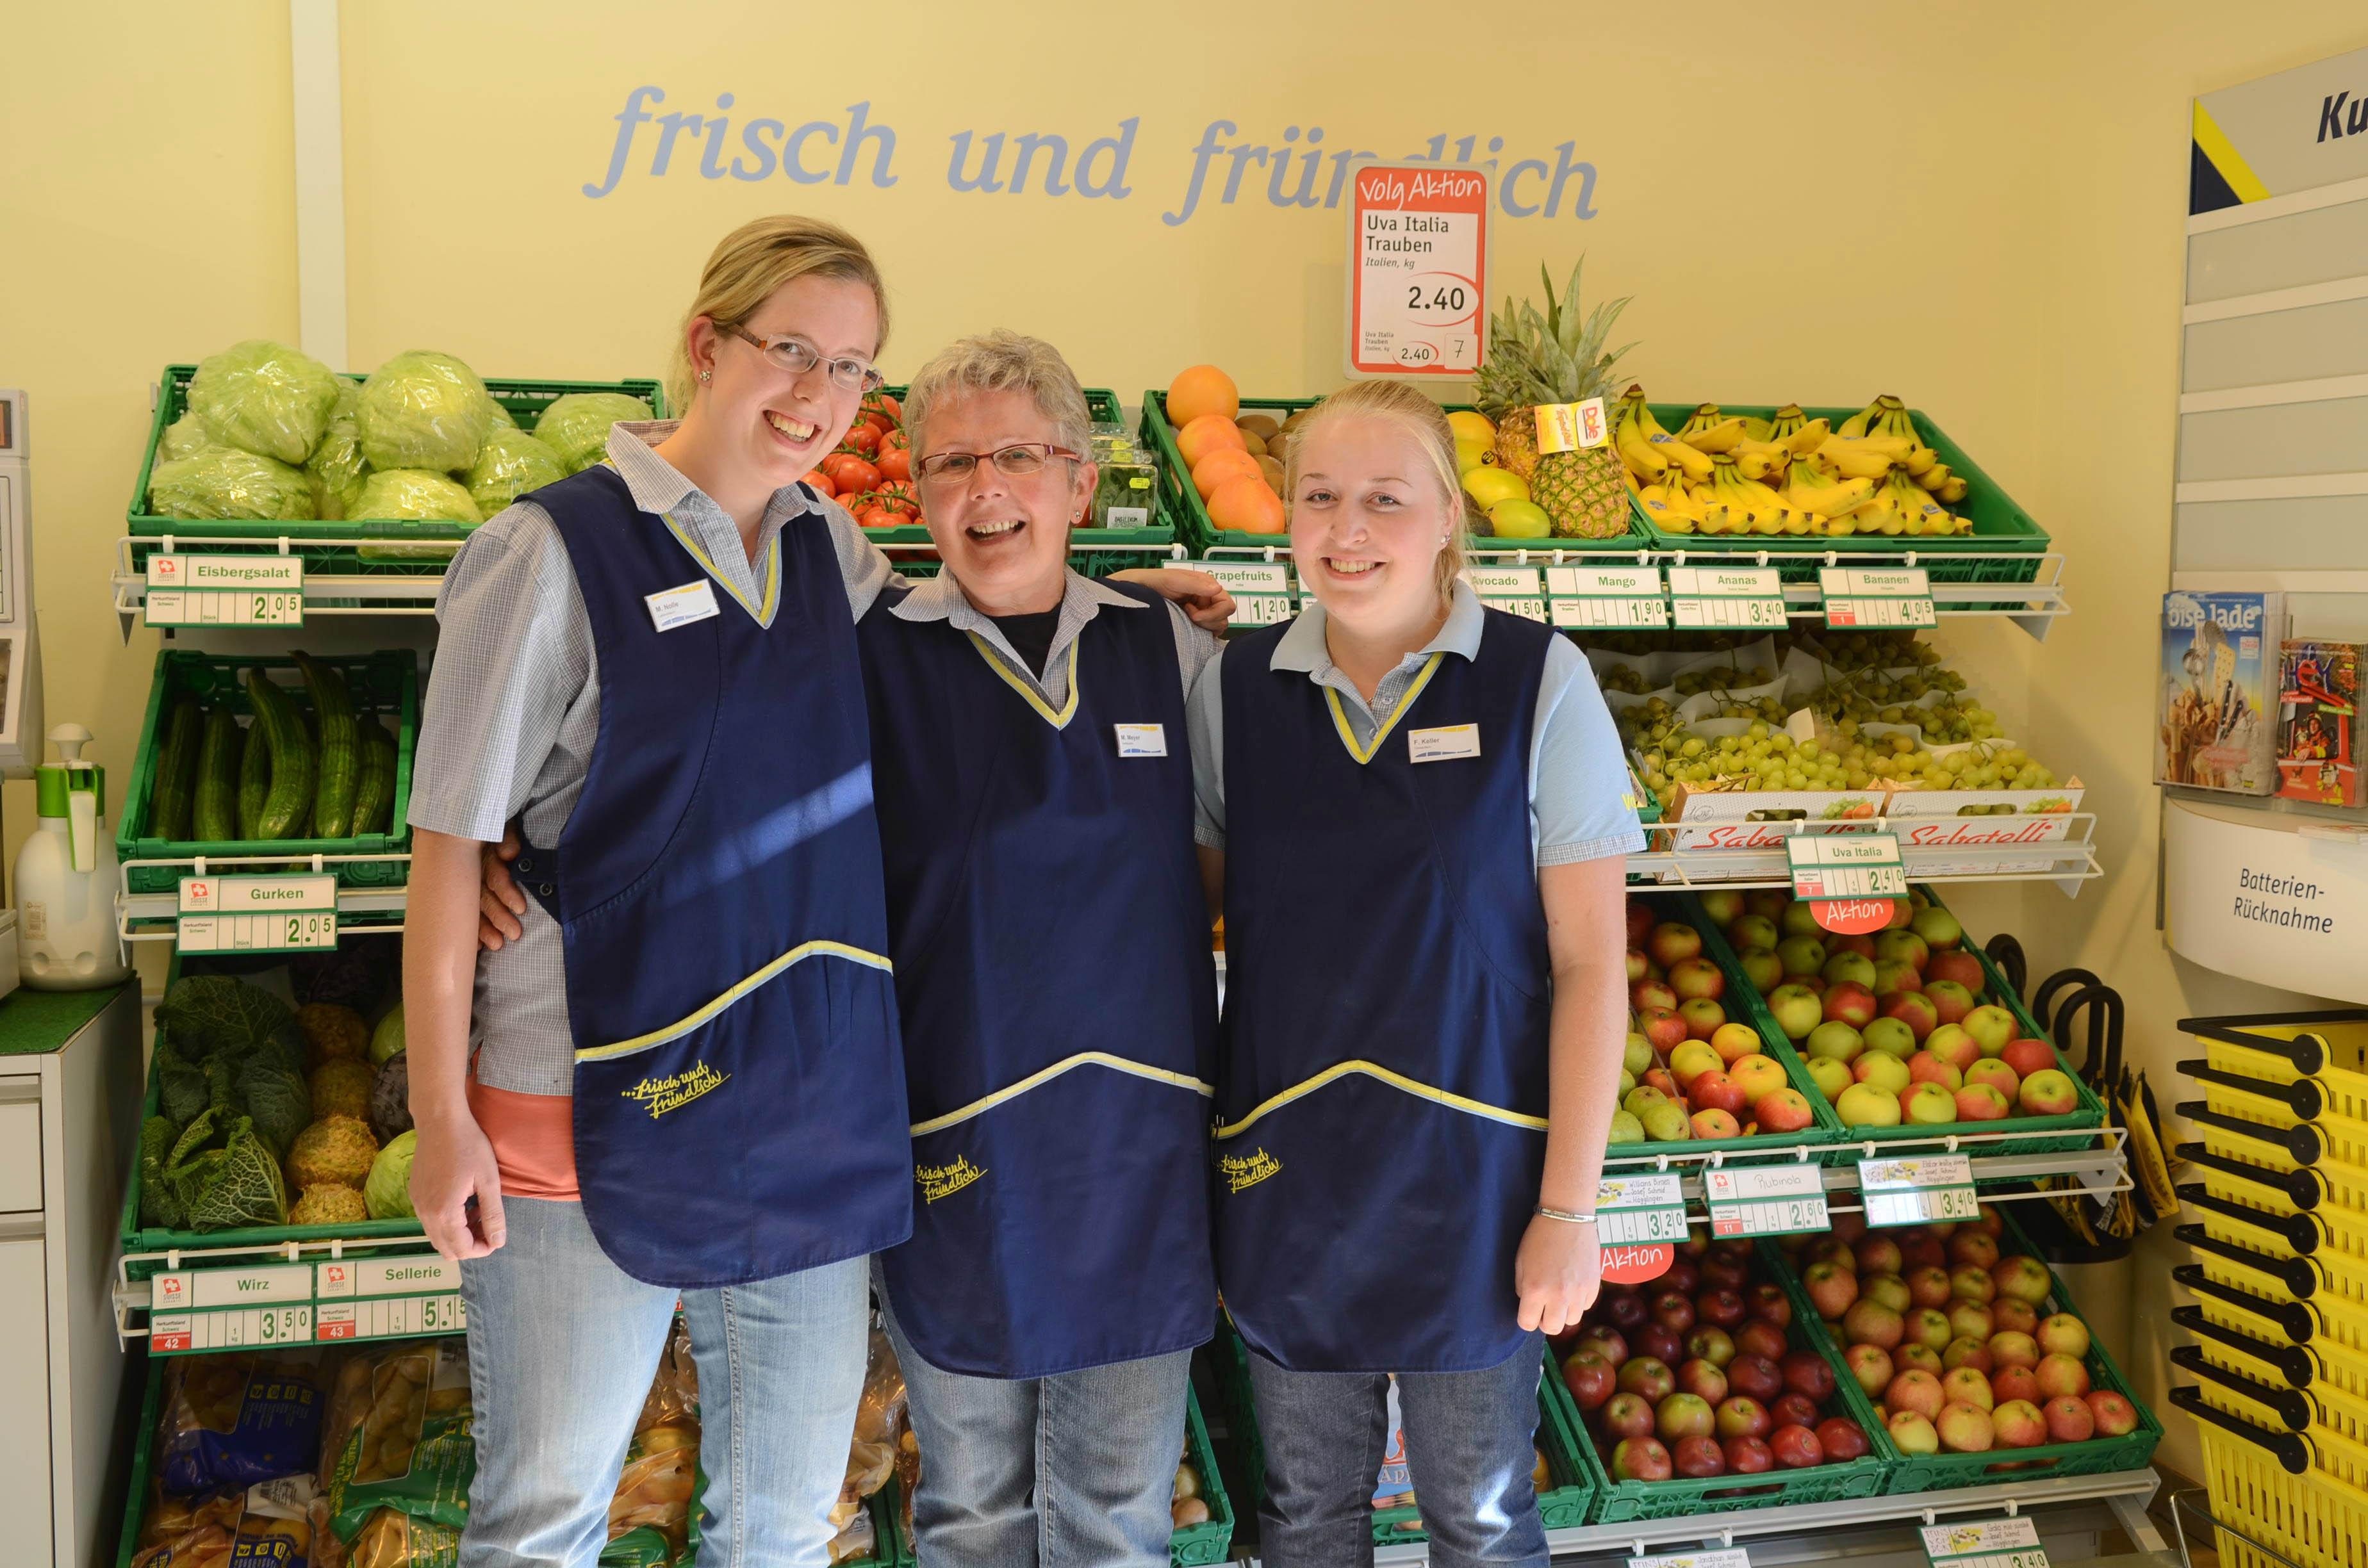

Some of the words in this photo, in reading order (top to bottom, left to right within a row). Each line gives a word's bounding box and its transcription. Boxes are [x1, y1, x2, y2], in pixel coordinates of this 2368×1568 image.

[582, 86, 898, 199] frisch
[948, 117, 1140, 200] und
[1408, 172, 1482, 202] Aktion
[1367, 215, 1397, 231] Uva
[1405, 216, 1449, 233] Italia
[1366, 236, 1433, 252] Trauben
[1365, 257, 1400, 268] Italien,
[1404, 259, 1415, 270] kg
[1408, 286, 1465, 310] 2.40
[1401, 348, 1429, 360] 2.40
[1584, 406, 1600, 439] Dole
[198, 566, 290, 580] Eisbergsalat
[1472, 576, 1518, 585] Avocado
[1598, 576, 1636, 587] Mango
[1718, 576, 1757, 585] Ananas
[1864, 575, 1909, 584] Bananen
[254, 596, 297, 619] 2.05
[1632, 602, 1662, 622] 1.90
[1751, 603, 1782, 623] 3.40
[1902, 601, 1930, 621] 4.05
[1833, 847, 1852, 857] Uva
[1855, 847, 1882, 857] Italia
[1870, 869, 1902, 891] 2.40
[2240, 868, 2324, 899] Batterien-
[251, 888, 304, 900] Gurken
[1807, 886, 1813, 895] 7
[1827, 899, 1884, 926] Aktion
[2233, 897, 2333, 933] Rücknahme
[288, 918, 331, 942] 2.05
[679, 1059, 709, 1084] und
[944, 1154, 968, 1176] und
[1246, 1147, 1269, 1167] und
[1754, 1173, 1802, 1190] Rubinola
[1943, 1192, 1973, 1214] 3.40
[1791, 1202, 1824, 1226] 2.60
[1650, 1213, 1683, 1237] 3.20
[1723, 1224, 1733, 1233] 11
[1601, 1245, 1663, 1275] Aktion
[386, 1266, 441, 1280] Sellerie
[237, 1278, 270, 1291] Wirz
[263, 1311, 308, 1339] 3.50
[329, 1327, 343, 1337] 43
[164, 1337, 179, 1350] 42
